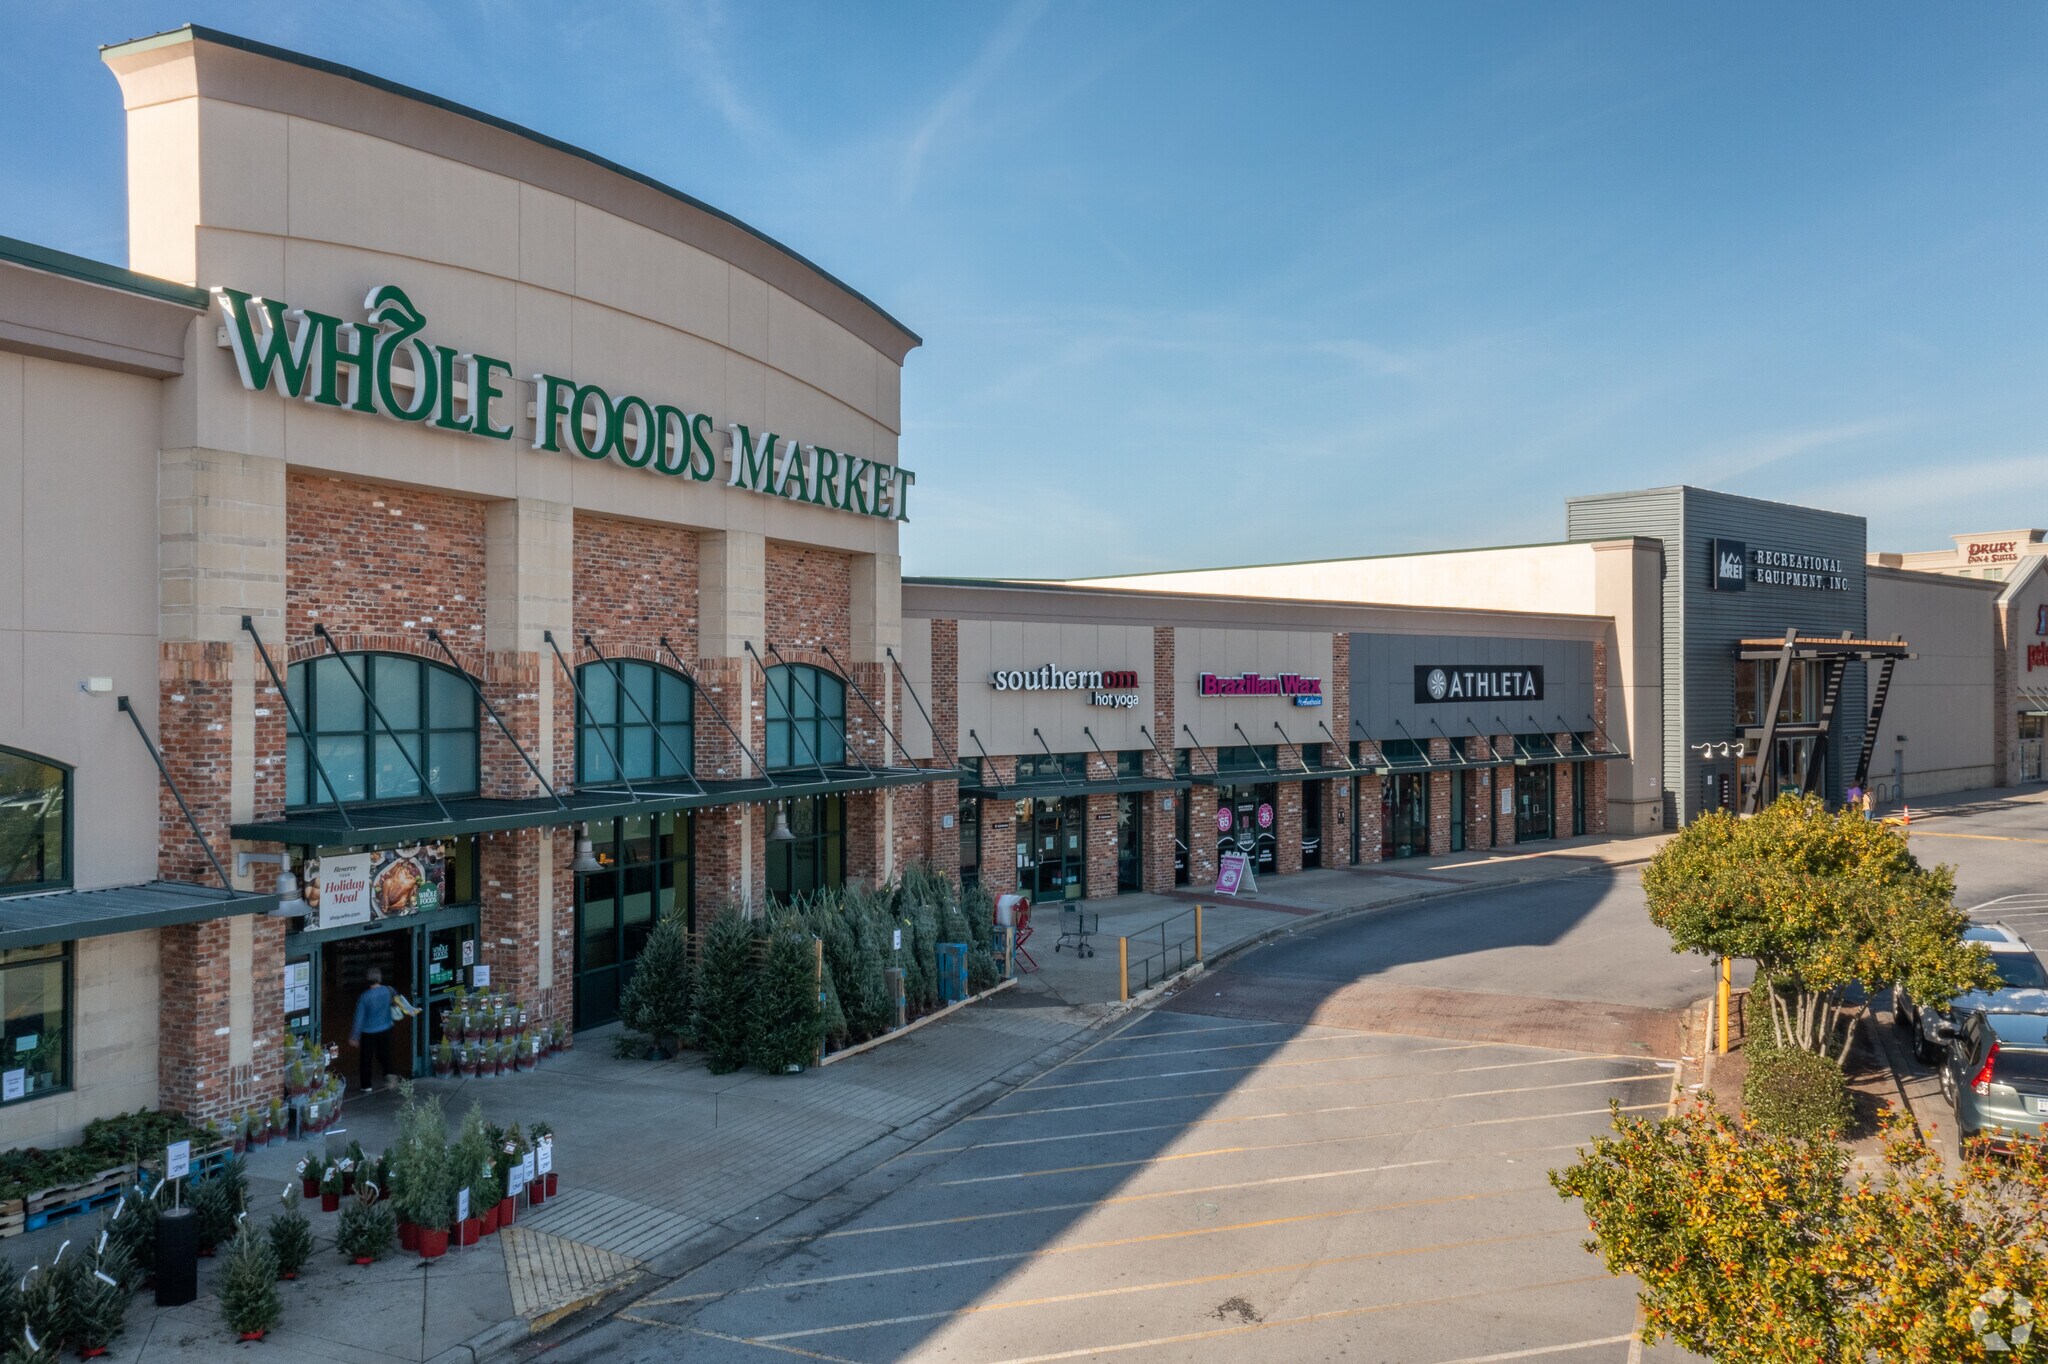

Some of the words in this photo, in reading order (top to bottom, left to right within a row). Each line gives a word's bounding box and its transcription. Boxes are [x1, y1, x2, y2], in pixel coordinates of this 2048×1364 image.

[210, 284, 514, 441] WHOLE
[532, 373, 716, 483] FOODS
[727, 423, 916, 523] MARKET
[1968, 541, 2017, 556] DRURY
[1756, 550, 1843, 573] RECREATIONAL
[1727, 563, 1743, 579] REI
[1756, 568, 1826, 591] EQUIPMENT,
[1829, 577, 1851, 591] INC.
[1200, 672, 1280, 697] Brazilian
[1279, 672, 1322, 696] Wax
[1448, 670, 1536, 698] ATHLETA
[1095, 691, 1113, 706] hot
[1114, 693, 1139, 708] yoga
[333, 865, 357, 873] Reserve
[325, 878, 365, 894] Holiday
[419, 888, 438, 899] WHOLE
[332, 892, 358, 905] Meal
